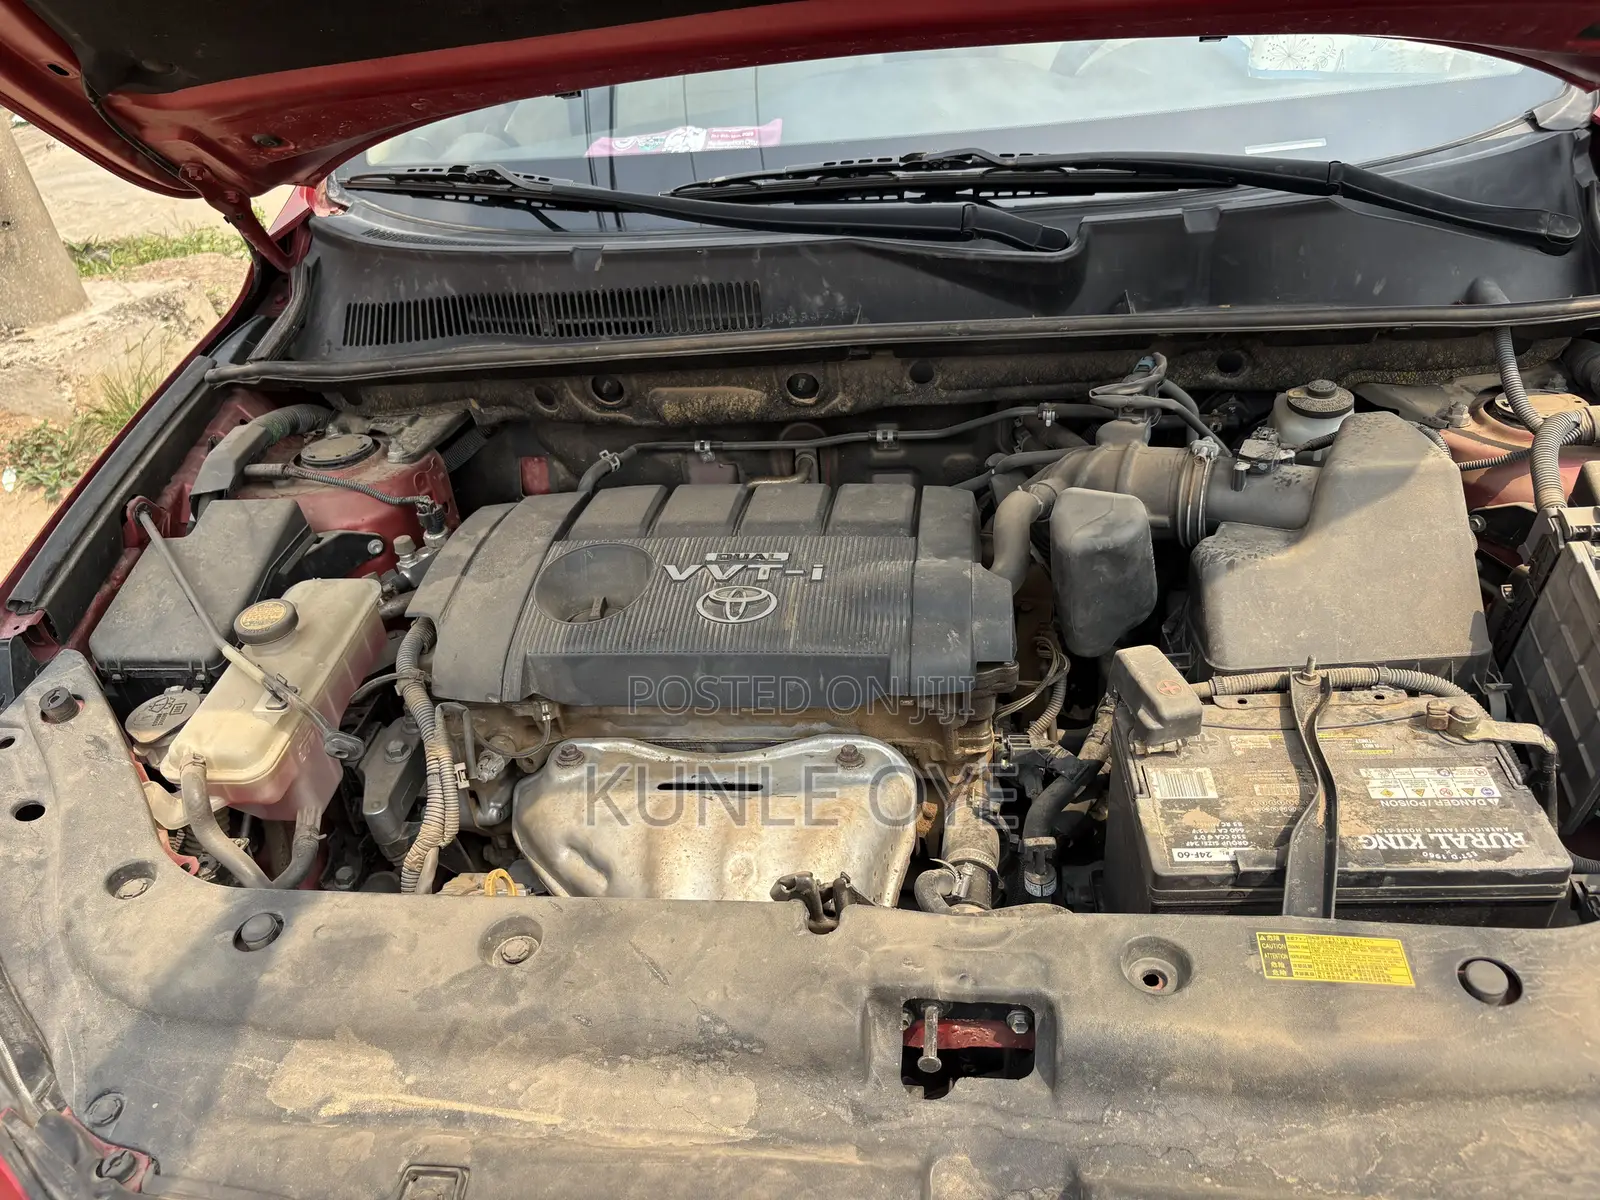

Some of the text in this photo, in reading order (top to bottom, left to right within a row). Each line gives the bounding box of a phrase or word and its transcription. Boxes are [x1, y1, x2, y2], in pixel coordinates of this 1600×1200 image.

[713, 553, 787, 562] DUAL
[663, 564, 824, 582] VVT-i
[1380, 799, 1426, 808] POISON
[1434, 798, 1487, 807] DANGER
[1358, 832, 1530, 850] RURAL KING
[1177, 851, 1213, 859] 24F-60
